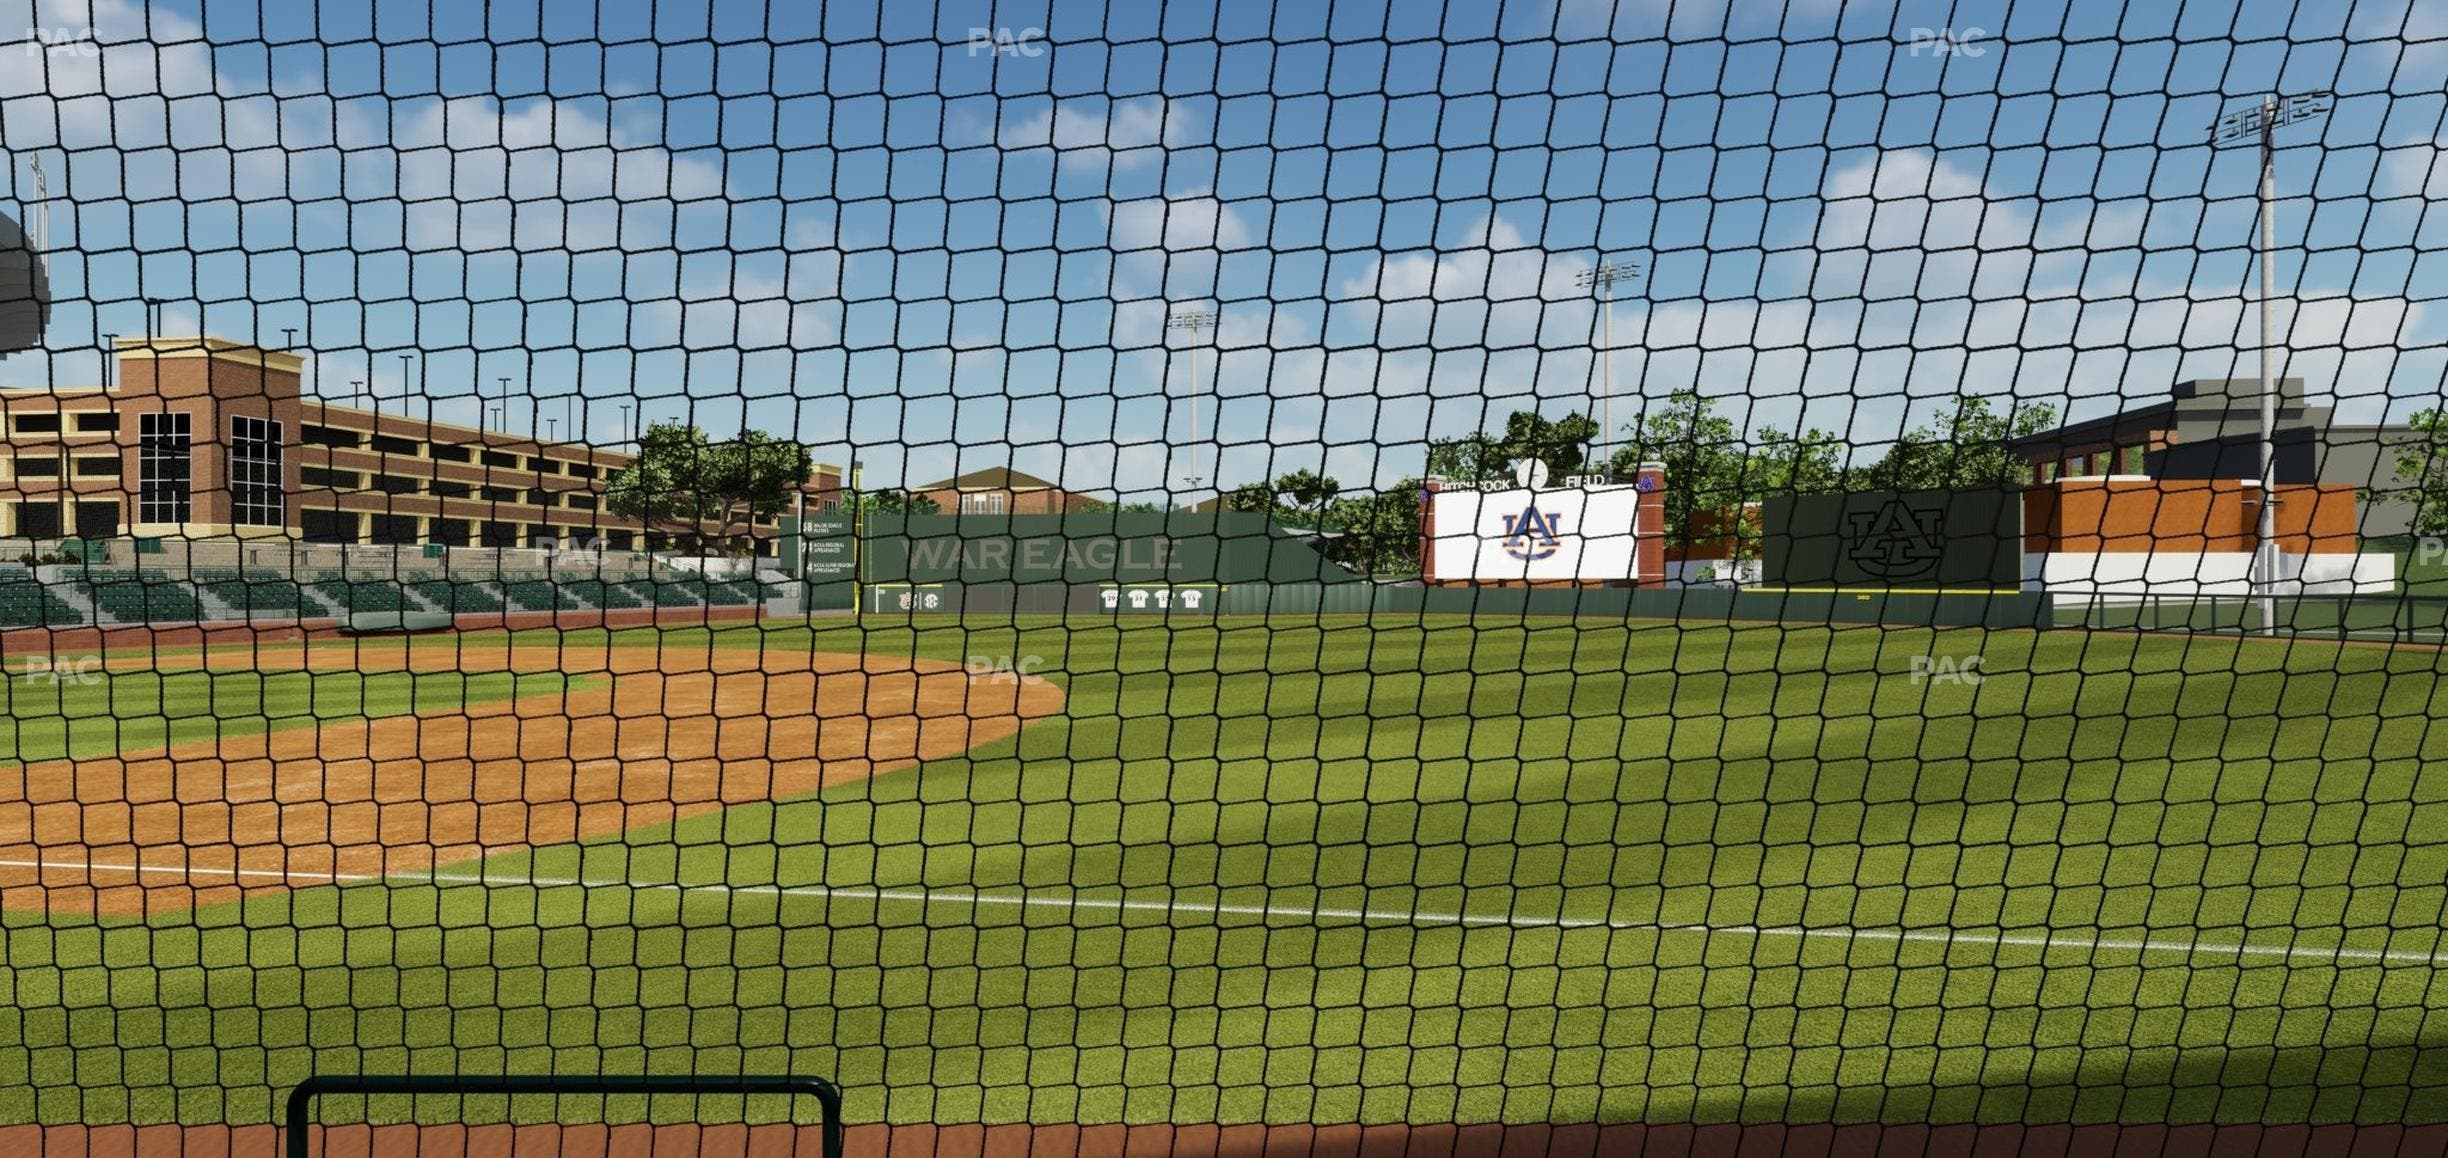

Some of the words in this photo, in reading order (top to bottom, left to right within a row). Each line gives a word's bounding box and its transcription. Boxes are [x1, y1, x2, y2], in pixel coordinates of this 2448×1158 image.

[1565, 474, 1605, 488] FIELD
[901, 538, 1008, 570] WAR
[1023, 537, 1183, 571] EAGLE
